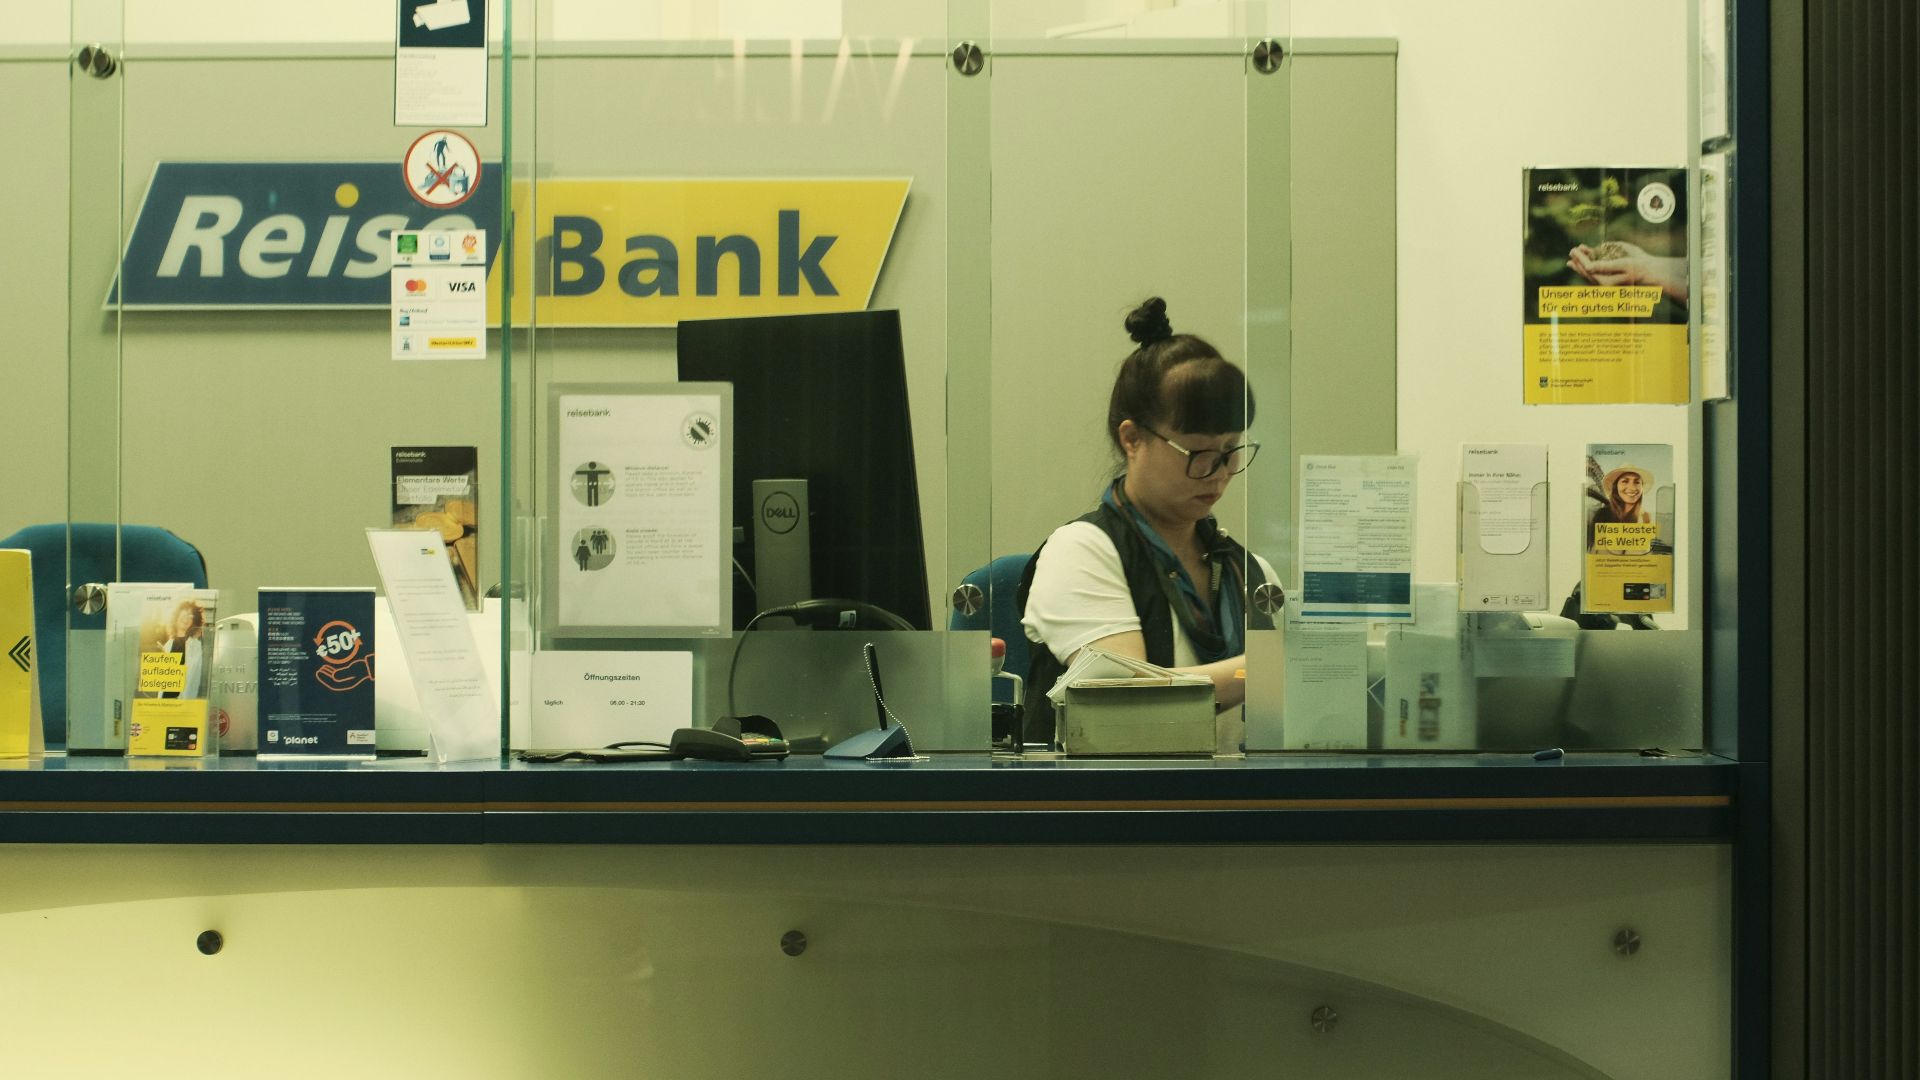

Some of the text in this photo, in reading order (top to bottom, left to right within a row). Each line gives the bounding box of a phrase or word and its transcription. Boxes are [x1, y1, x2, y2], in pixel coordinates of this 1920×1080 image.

[1538, 182, 1579, 192] reisebank
[156, 182, 841, 297] Reis Bank
[449, 282, 476, 292] VISA
[1541, 289, 1659, 301] Unser aktiver Beitrag
[1542, 302, 1650, 314] für ein gutes Klima.
[567, 409, 611, 418] reisebank
[766, 507, 796, 518] DELL
[1597, 524, 1657, 534] Was kostet
[1597, 537, 1646, 546] die Welt?
[143, 653, 178, 664] Kaufen,
[142, 666, 184, 677] aufladen,
[584, 672, 641, 682] Öffnungszeiten
[140, 679, 181, 689] loslegen!
